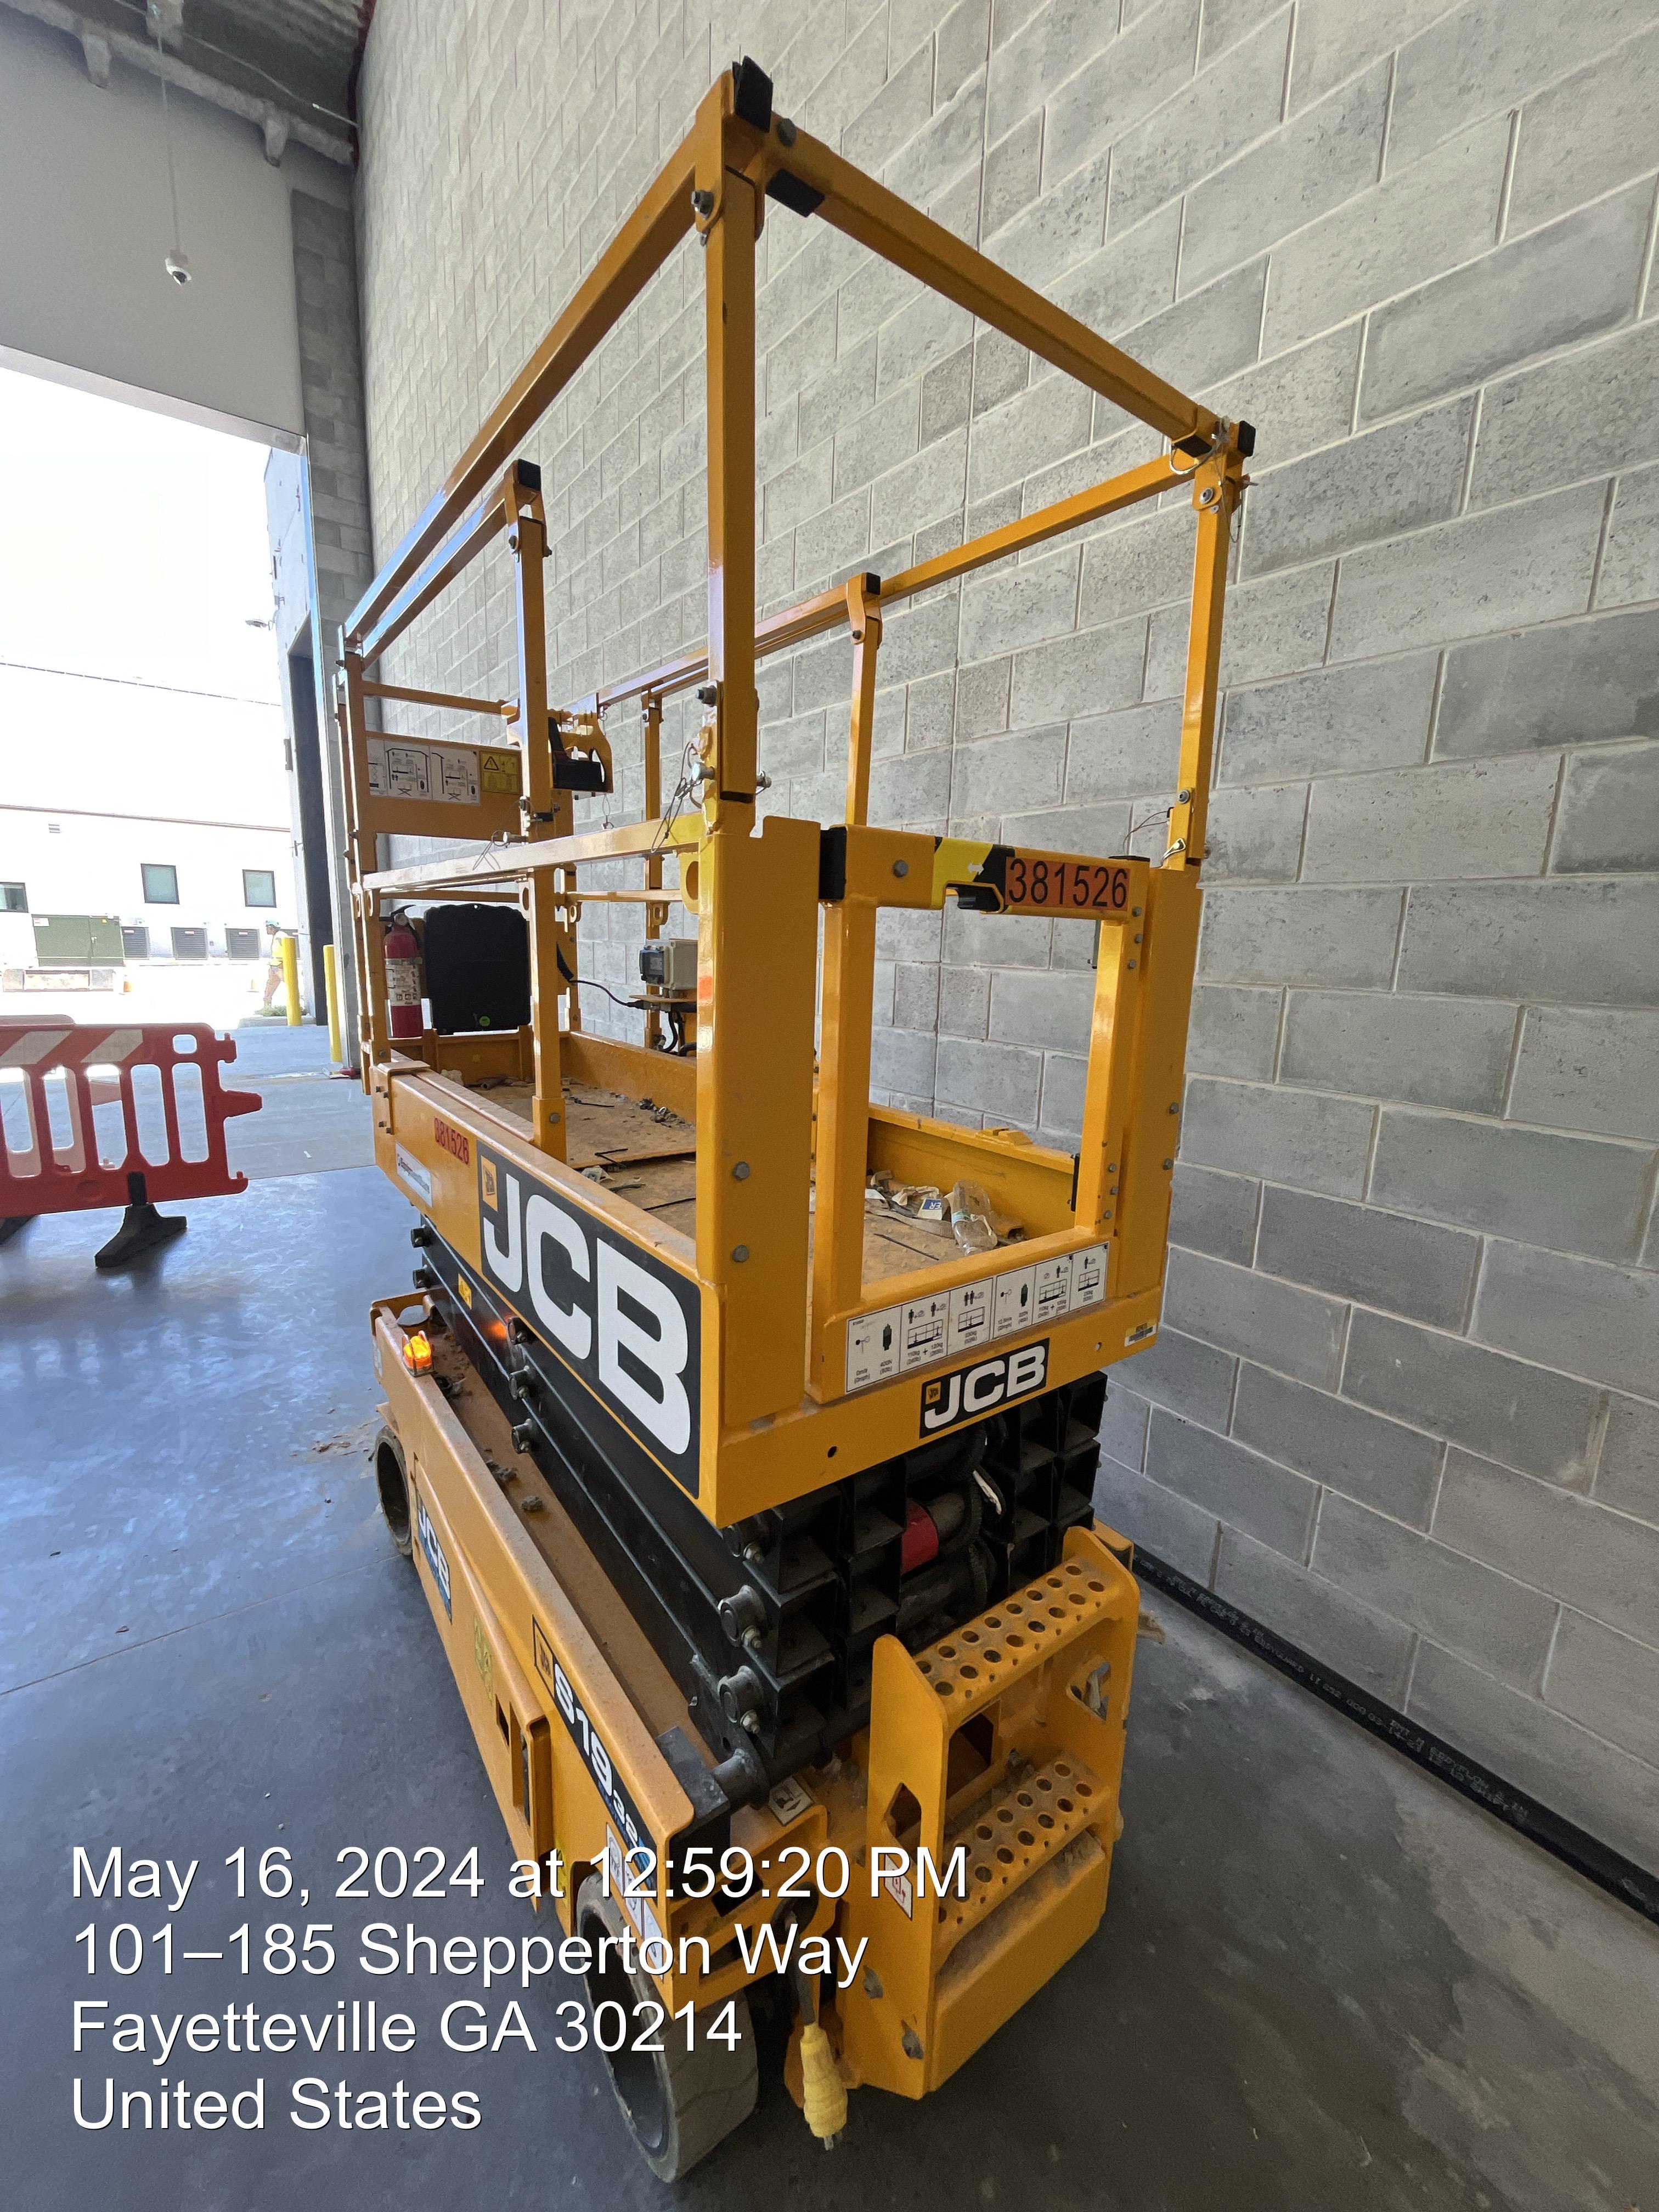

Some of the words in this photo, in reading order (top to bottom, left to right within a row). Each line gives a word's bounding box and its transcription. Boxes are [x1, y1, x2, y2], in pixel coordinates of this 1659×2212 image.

[1009, 858, 1127, 909] 381526
[483, 1172, 690, 1454] JCB
[925, 1346, 1045, 1429] JCB
[418, 1505, 450, 1600] JCB
